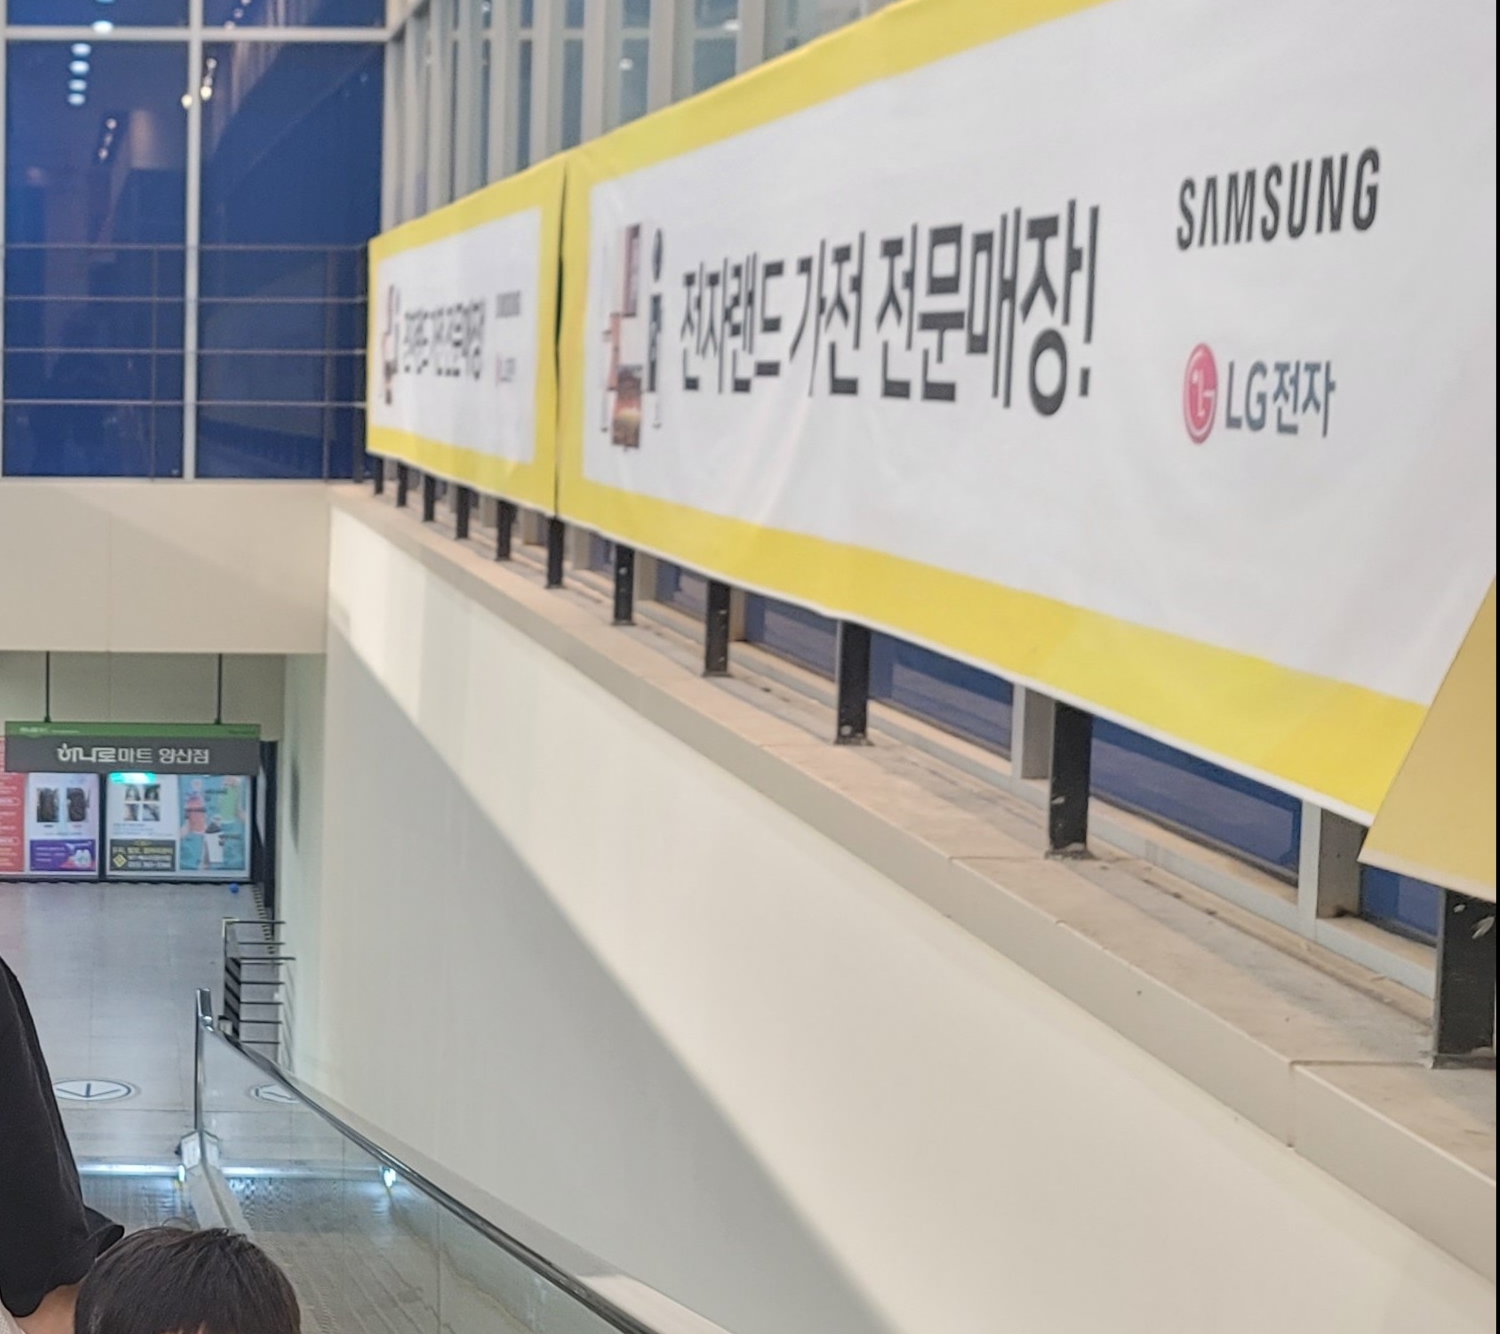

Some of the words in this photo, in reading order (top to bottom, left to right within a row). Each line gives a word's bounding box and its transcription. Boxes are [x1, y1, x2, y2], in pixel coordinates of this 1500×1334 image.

[1176, 146, 1381, 252] SAMSUNG
[680, 250, 785, 395] 전자랜드
[789, 230, 866, 398] 가전
[875, 198, 1101, 418] 전문매장!
[1224, 359, 1337, 439] LG전자
[56, 742, 153, 764] 하나로마트
[157, 747, 211, 765] 양산점
